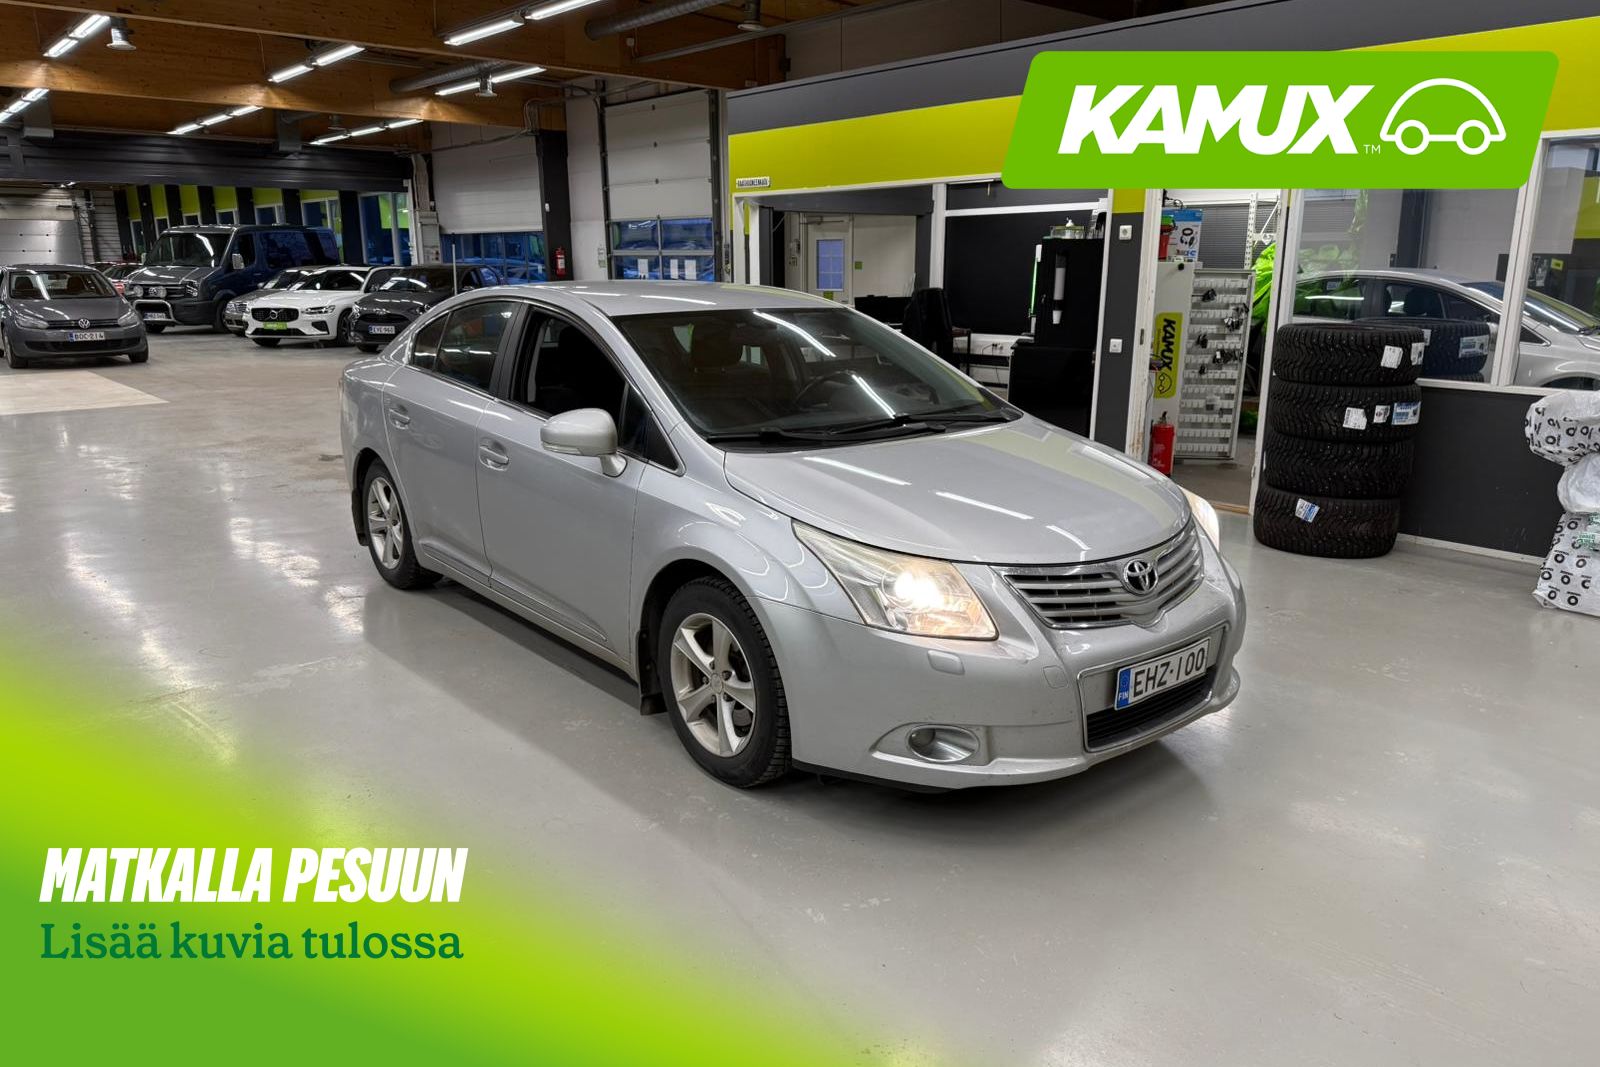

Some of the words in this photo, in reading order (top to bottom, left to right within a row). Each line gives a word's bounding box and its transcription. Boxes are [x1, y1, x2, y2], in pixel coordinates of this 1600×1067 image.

[1159, 318, 1176, 371] KAMUX
[1118, 690, 1129, 701] FIN
[1133, 647, 1206, 698] EHZ-100
